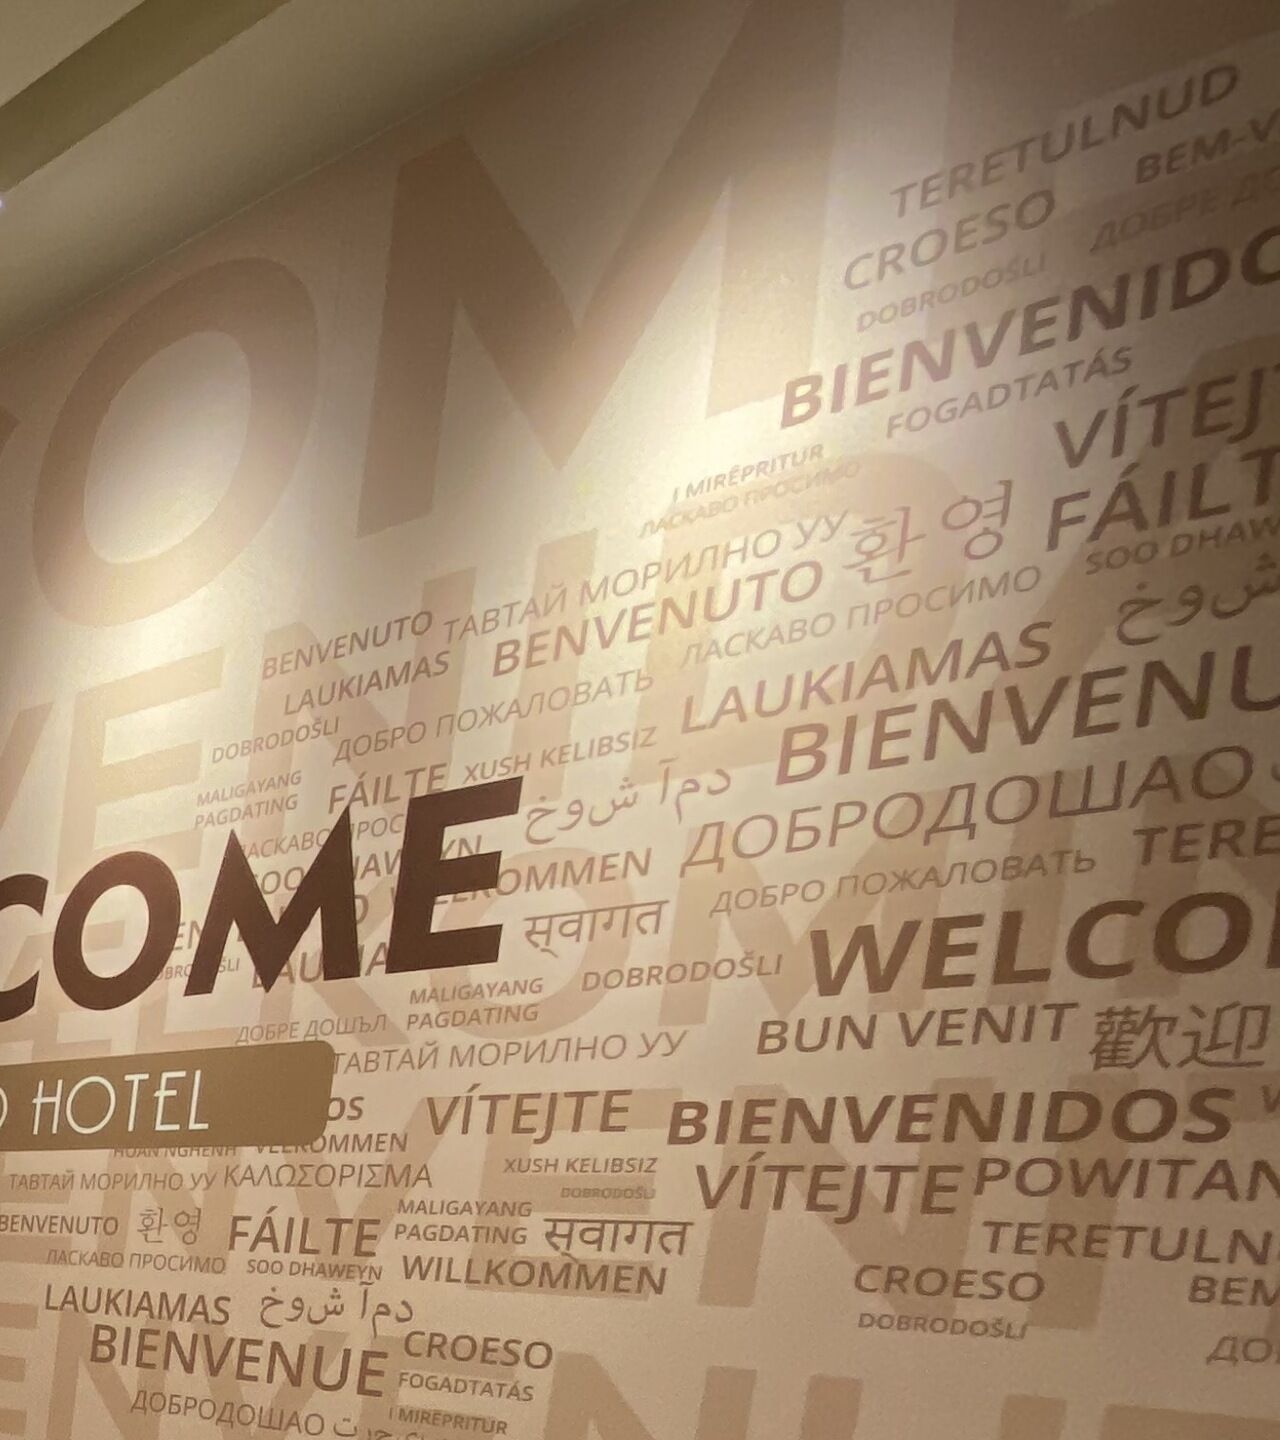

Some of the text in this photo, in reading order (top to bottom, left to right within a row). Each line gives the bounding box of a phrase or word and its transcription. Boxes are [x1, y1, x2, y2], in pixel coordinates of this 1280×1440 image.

[890, 64, 1239, 218] TERETULNUD
[844, 189, 1056, 291] CROESO
[886, 346, 1135, 439] FOGADTATÁS
[1053, 360, 1280, 470] VÍTEJ
[1085, 540, 1159, 577] SOO
[442, 583, 568, 646] ТАВТАЙ
[578, 529, 782, 606] МОРИЛНО
[491, 560, 823, 678] BENVENUTO
[679, 565, 1041, 670] ЛАСКАВО ПРОСИМО
[261, 610, 433, 681] BENVENUTO
[283, 650, 450, 716] LAUKIAMAS
[680, 621, 1053, 735] LAUKIAMAS
[210, 716, 341, 764] DOBRODOŠLI
[332, 667, 655, 767] ДОБРО ПОЖАЛОВАТЬ
[462, 725, 660, 786] XUSH KELIBSIZ
[192, 794, 299, 831] PAGDATING
[196, 769, 302, 808] MALIGAYANG
[327, 763, 448, 814] FÁILTE
[679, 744, 1254, 878] ДОБРОДОШАО
[709, 847, 1097, 918] ДОБРО ПОЖАЛОВАТЬ
[809, 889, 1280, 997] WELCO
[410, 977, 543, 1005] MALIGAYANG
[581, 952, 782, 993] DOBRODOŠLI
[406, 1003, 539, 1031] PAGDATING
[756, 1001, 1080, 1056] BUN VENIT
[449, 1034, 627, 1068] МОРИЛНО
[31, 1069, 209, 1136] HOTEL
[426, 1083, 633, 1145] VÍTEJTE
[666, 1086, 1236, 1146] BIENVENIDOS
[9, 1170, 74, 1191] ТАВТАЙ
[80, 1172, 183, 1192] МОРИЛНО
[503, 1157, 658, 1175] XUSH KELIBSIZ
[695, 1150, 966, 1225] VÍTEJTE
[228, 1206, 382, 1258] FÁILTE
[393, 1223, 528, 1245] PAGDATING
[397, 1199, 533, 1218] MALIGAYANG
[46, 1248, 226, 1275] ЛАСКАВО ПРОСИМО
[982, 1220, 1280, 1265] TERETULN
[246, 1259, 383, 1282] SOO DHAWEYN
[401, 1255, 669, 1296] WILLKOMMEN
[854, 1264, 1046, 1302] CROESO
[44, 1284, 231, 1326] LAUKIAMAS
[858, 1312, 1028, 1340] DOBRODOŠLI
[90, 1323, 389, 1398] BIENVENUE
[403, 1330, 553, 1370] CROESO
[397, 1371, 535, 1403] FOGADTATÁS
[130, 1390, 326, 1437] ДОБРОДОШАО
